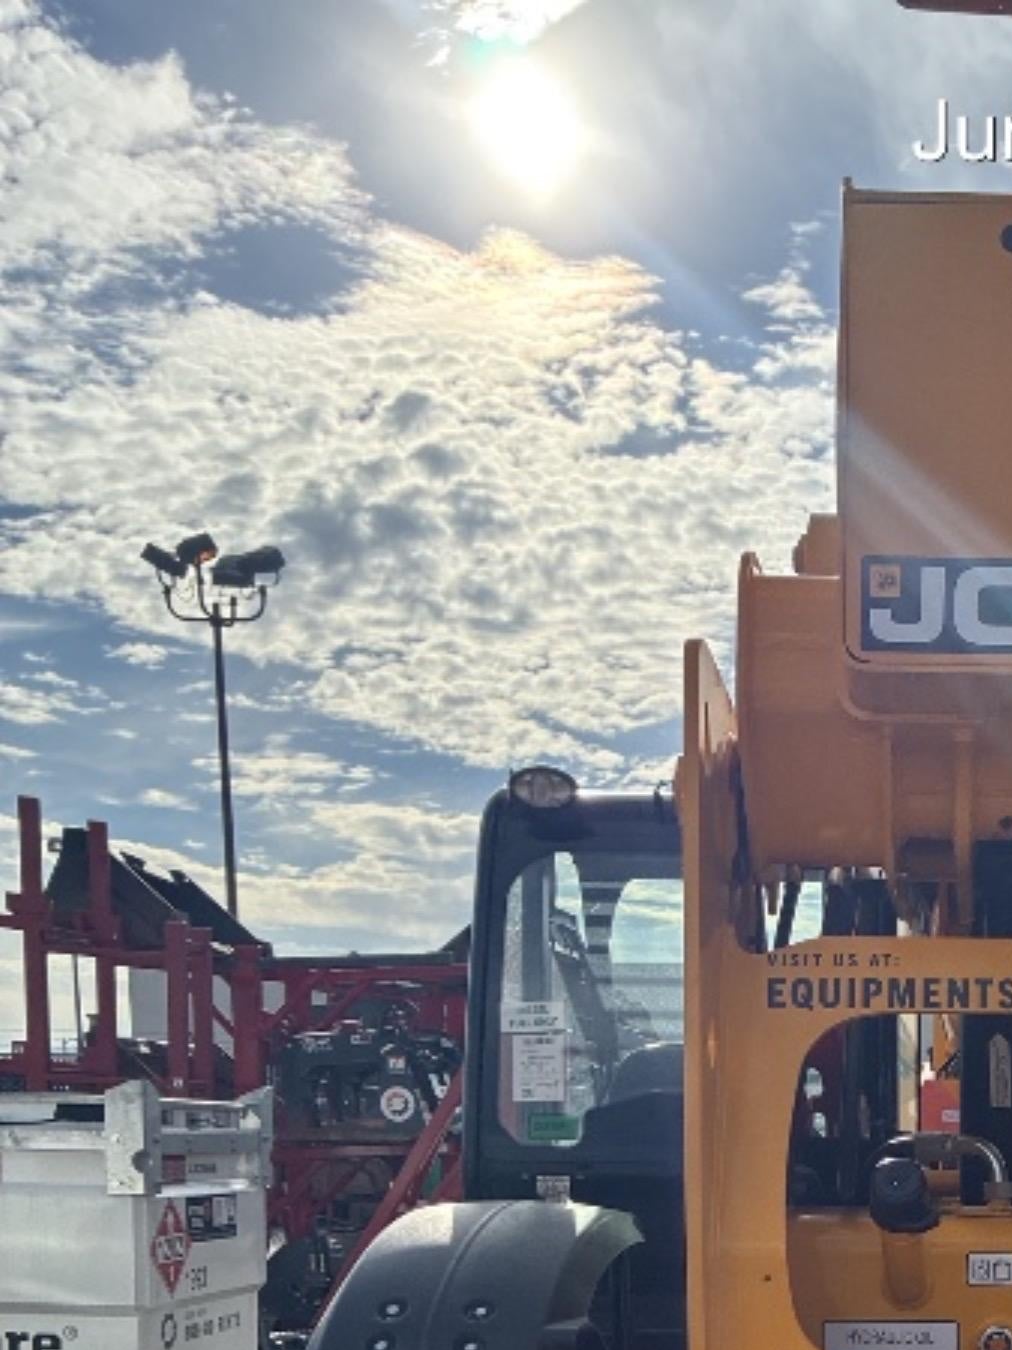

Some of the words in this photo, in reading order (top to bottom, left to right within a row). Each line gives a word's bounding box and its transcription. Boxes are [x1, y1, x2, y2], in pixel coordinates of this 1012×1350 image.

[766, 953, 823, 967] VISIT
[833, 953, 859, 967] US
[869, 953, 900, 967] AT:
